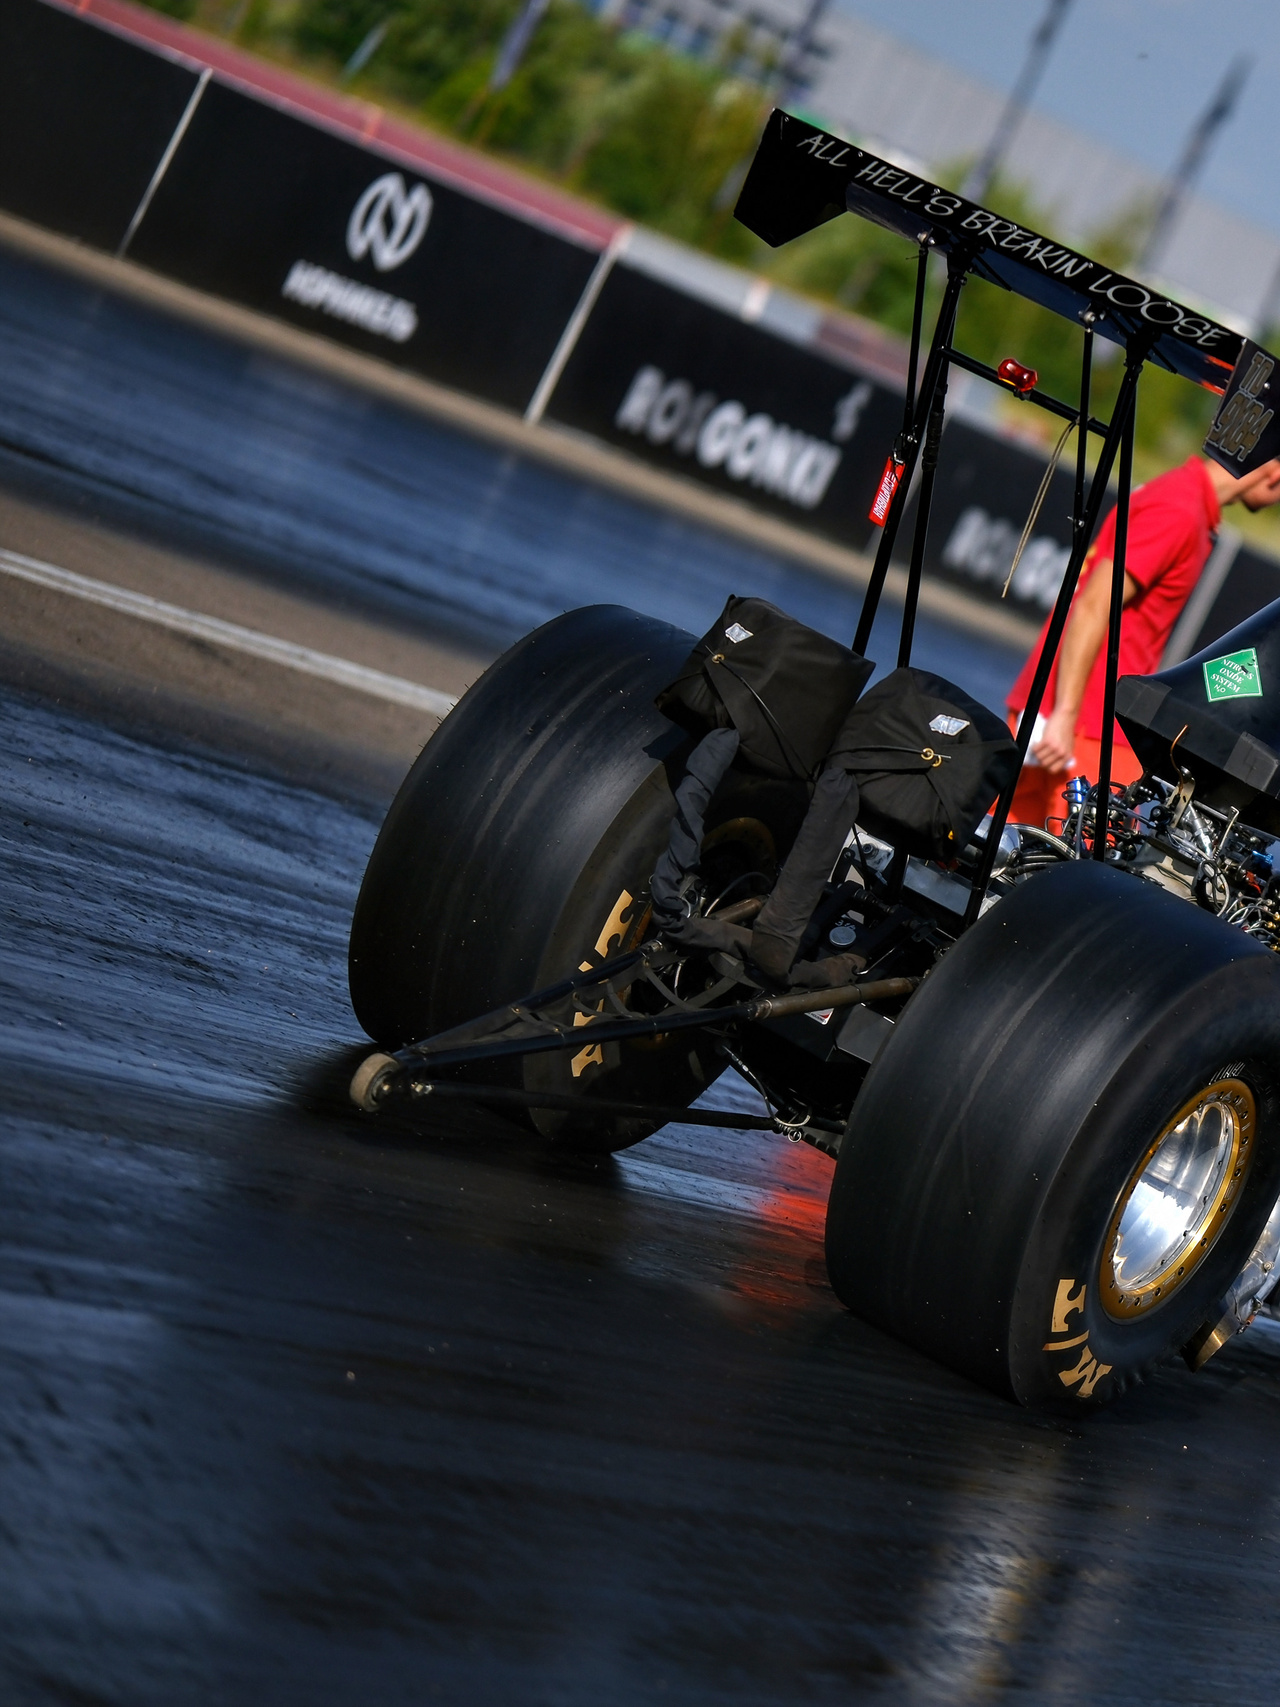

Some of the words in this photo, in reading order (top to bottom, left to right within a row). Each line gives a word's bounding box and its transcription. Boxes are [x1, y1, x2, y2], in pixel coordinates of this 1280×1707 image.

[797, 134, 848, 168] ALL
[853, 160, 962, 217] HELL'S
[1088, 274, 1231, 347] LOOSE
[1239, 351, 1275, 398] TD
[1210, 673, 1241, 693] SYSTEM
[1219, 667, 1244, 685] OXIDE
